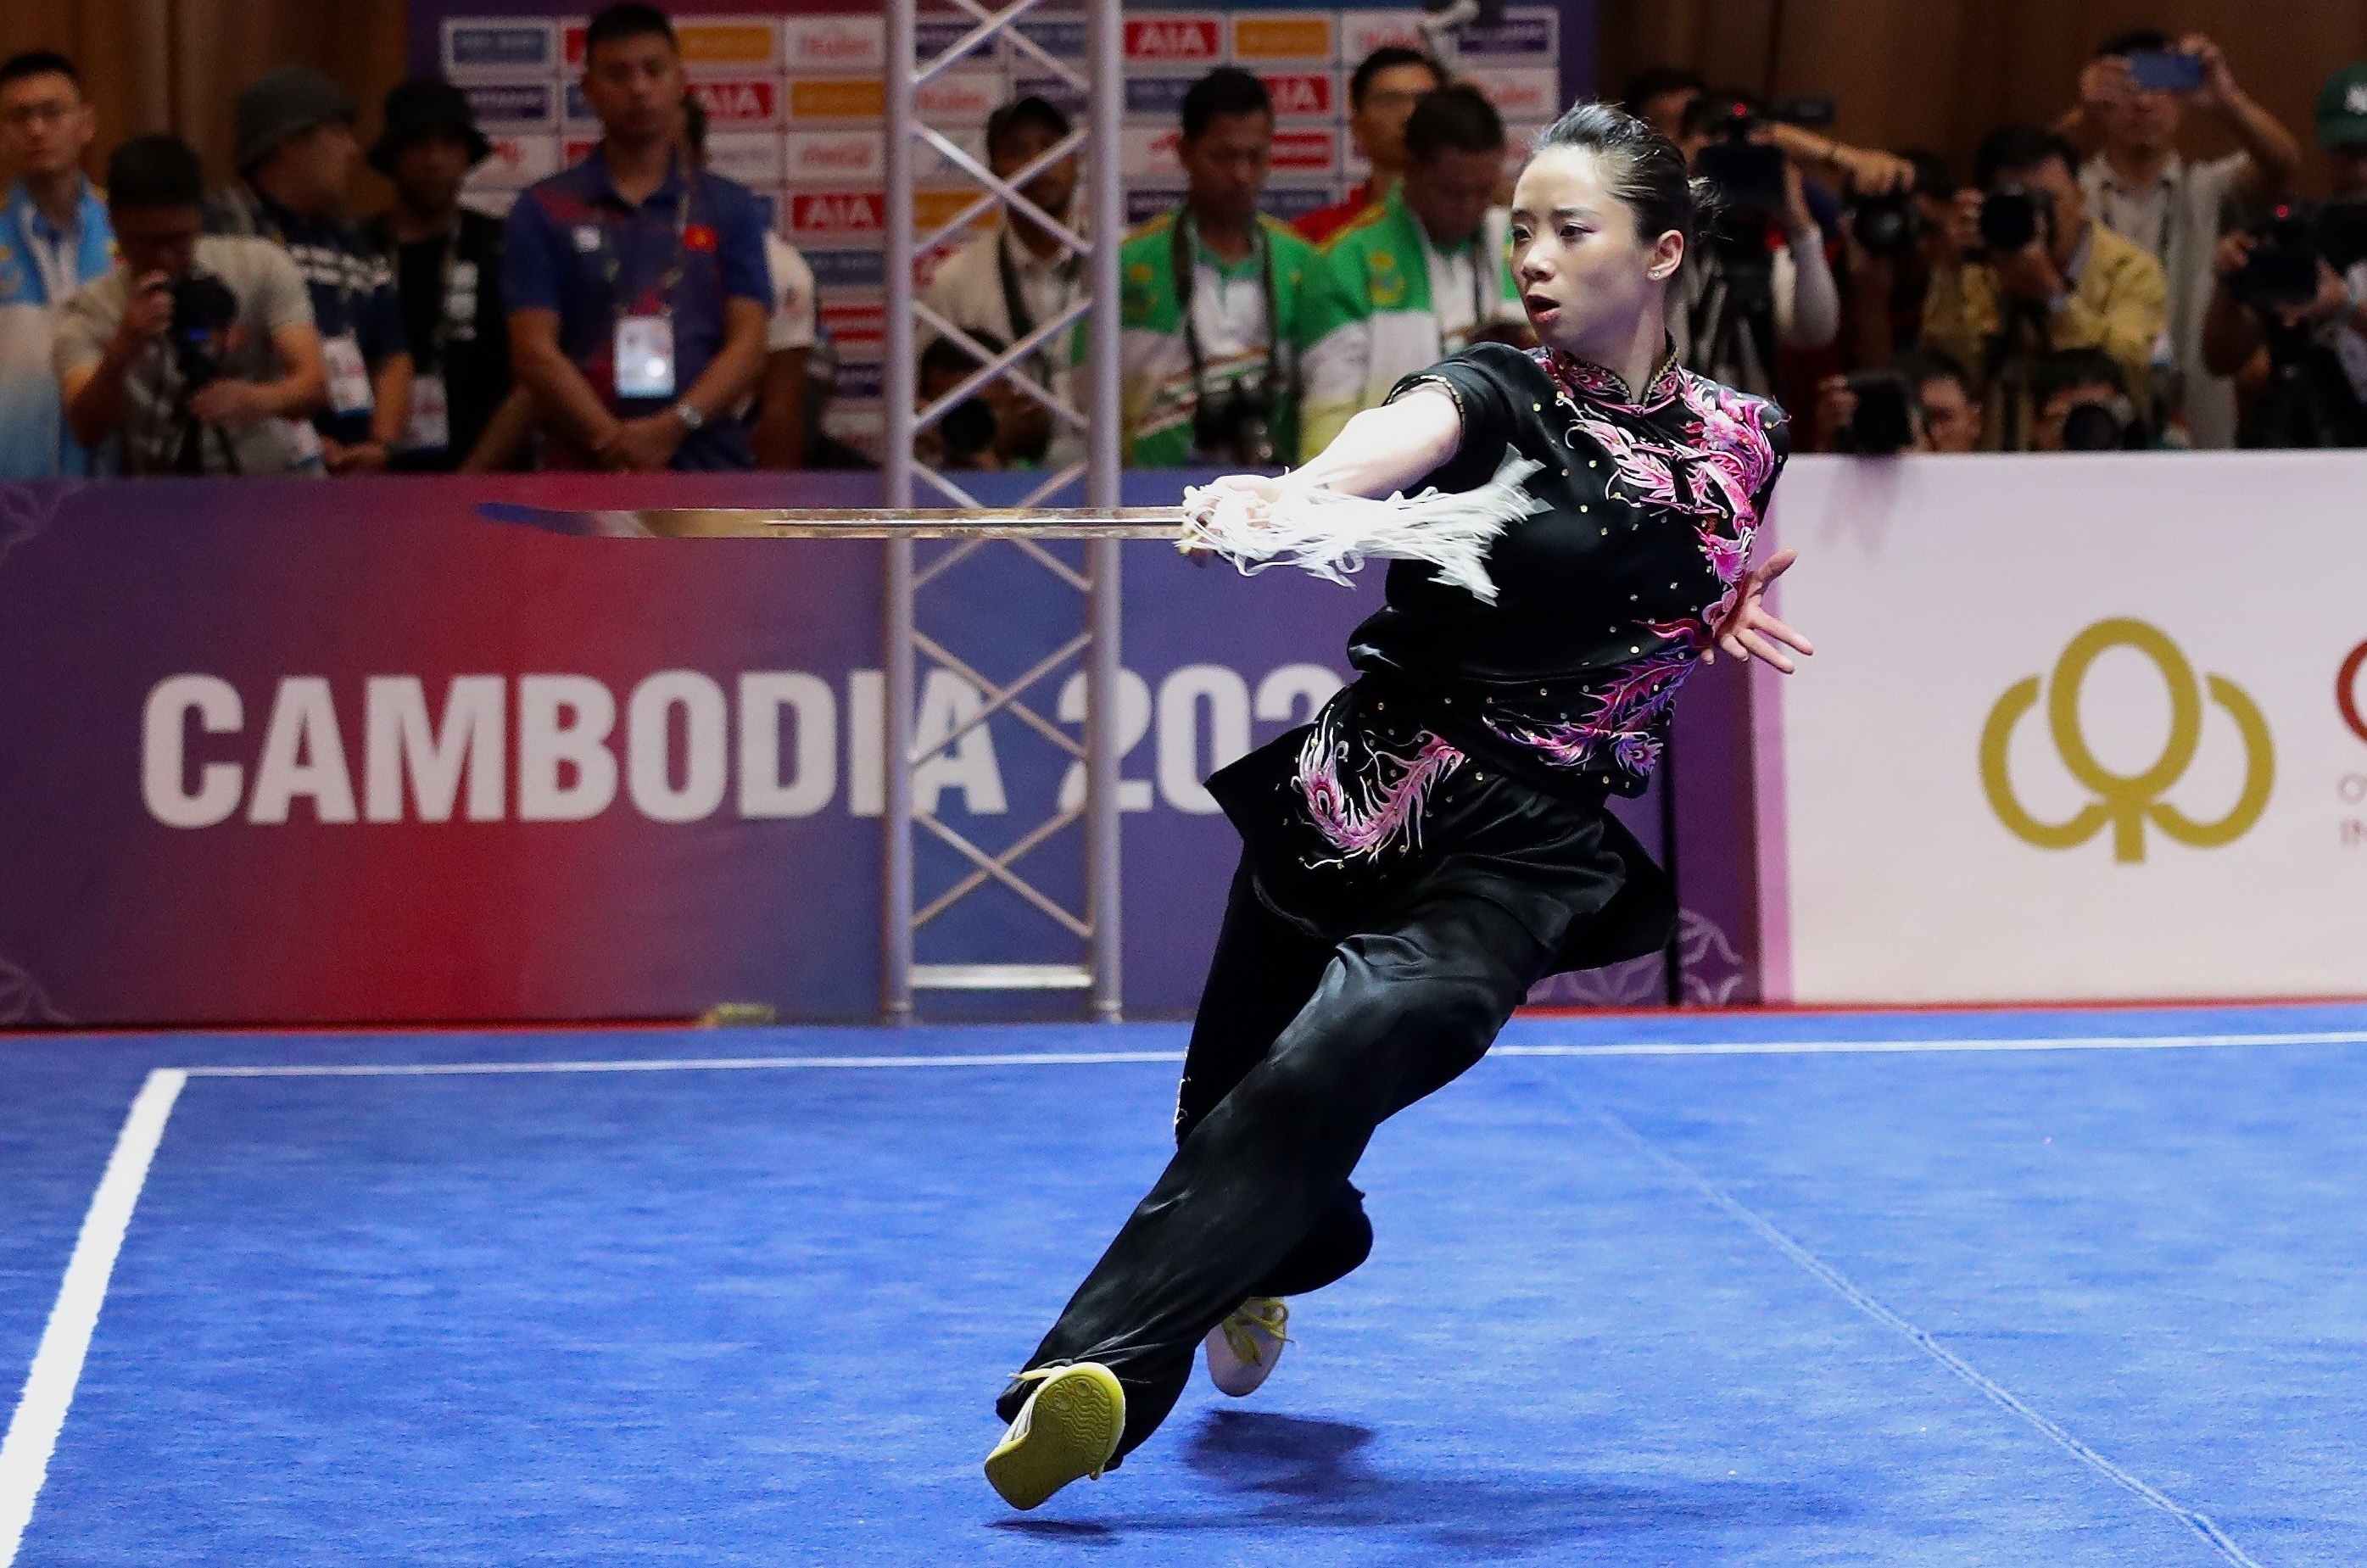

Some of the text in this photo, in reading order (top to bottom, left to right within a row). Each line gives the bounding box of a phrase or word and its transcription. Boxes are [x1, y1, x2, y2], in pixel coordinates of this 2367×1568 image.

[1136, 23, 1211, 56] AIA
[1272, 81, 1325, 114] IA
[805, 197, 876, 230] AIA
[141, 669, 1008, 828] CAMBODIA
